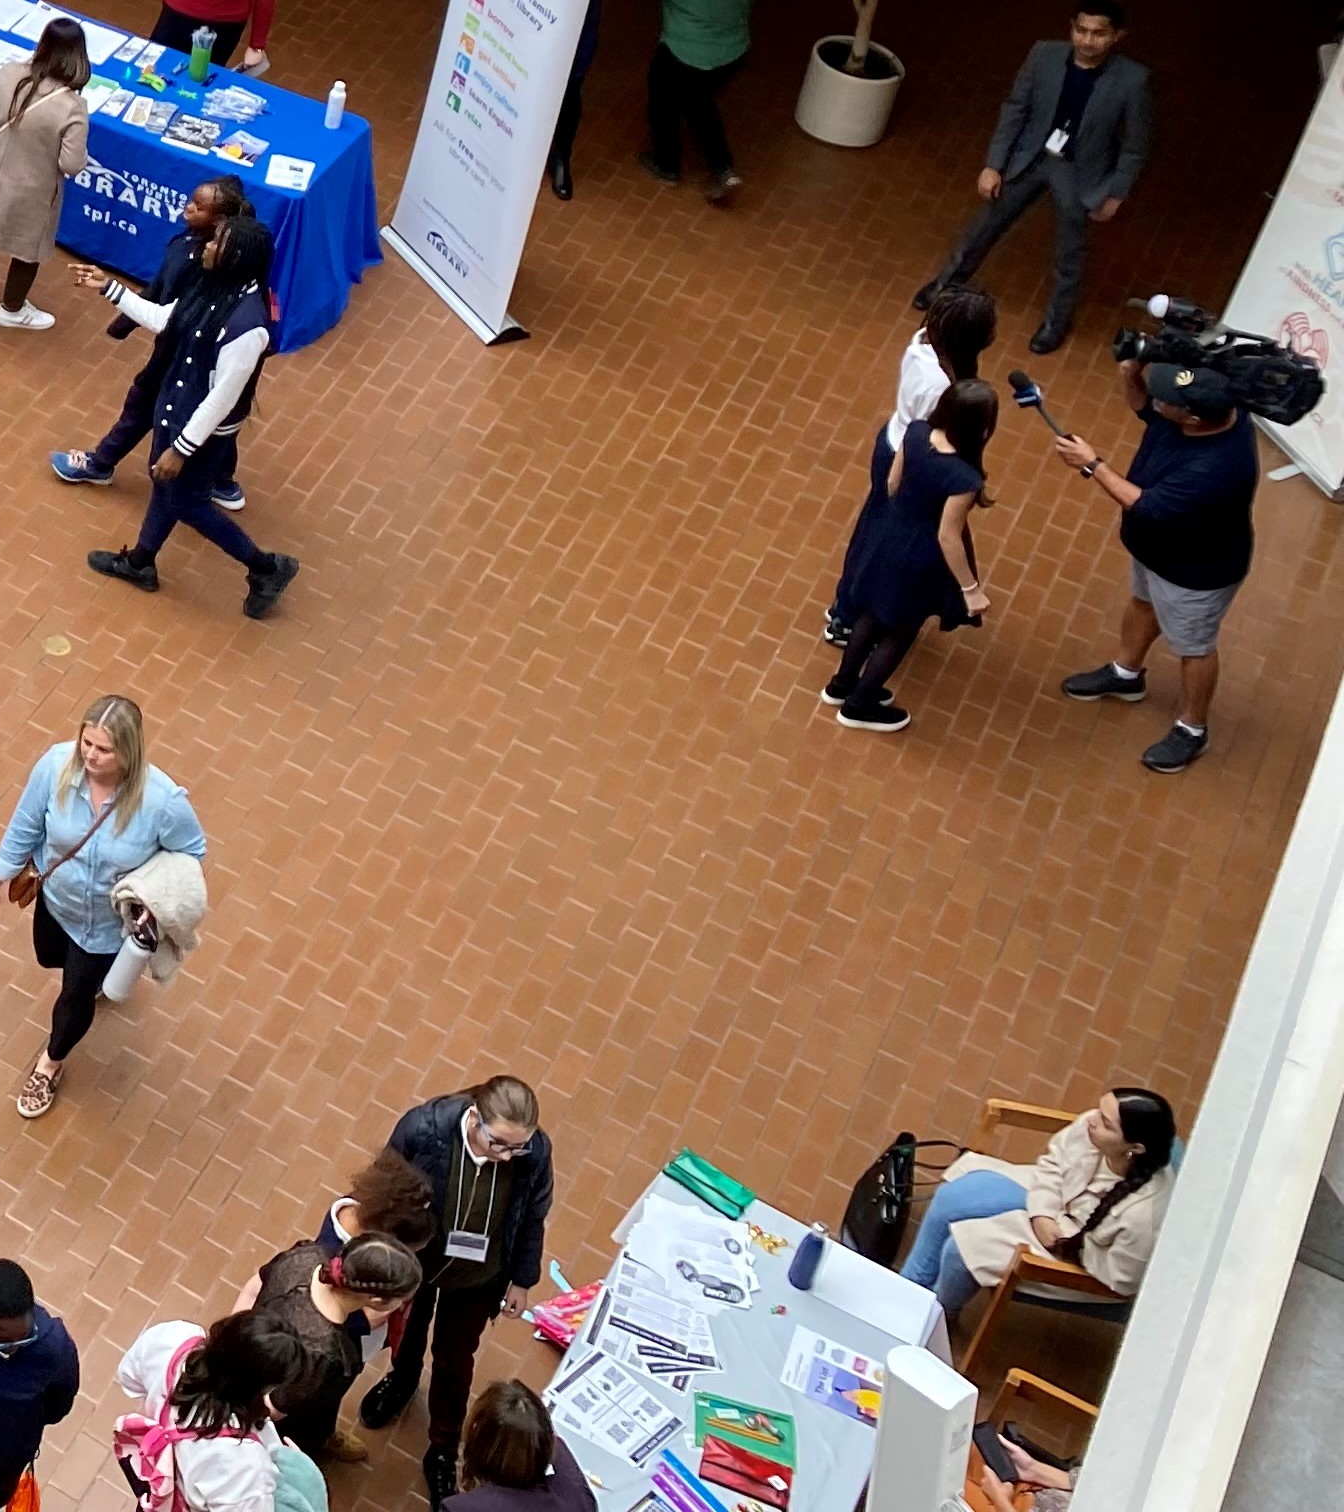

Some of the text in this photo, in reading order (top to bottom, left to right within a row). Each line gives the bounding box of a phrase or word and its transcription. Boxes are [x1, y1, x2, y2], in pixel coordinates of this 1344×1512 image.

[487, 7, 515, 39] borrow
[463, 107, 482, 131] relax
[458, 138, 474, 161] free
[64, 169, 185, 224] BRARY
[122, 169, 188, 201] TORONTO
[82, 203, 138, 236] tpl.ca
[426, 233, 468, 279] LIBRARY
